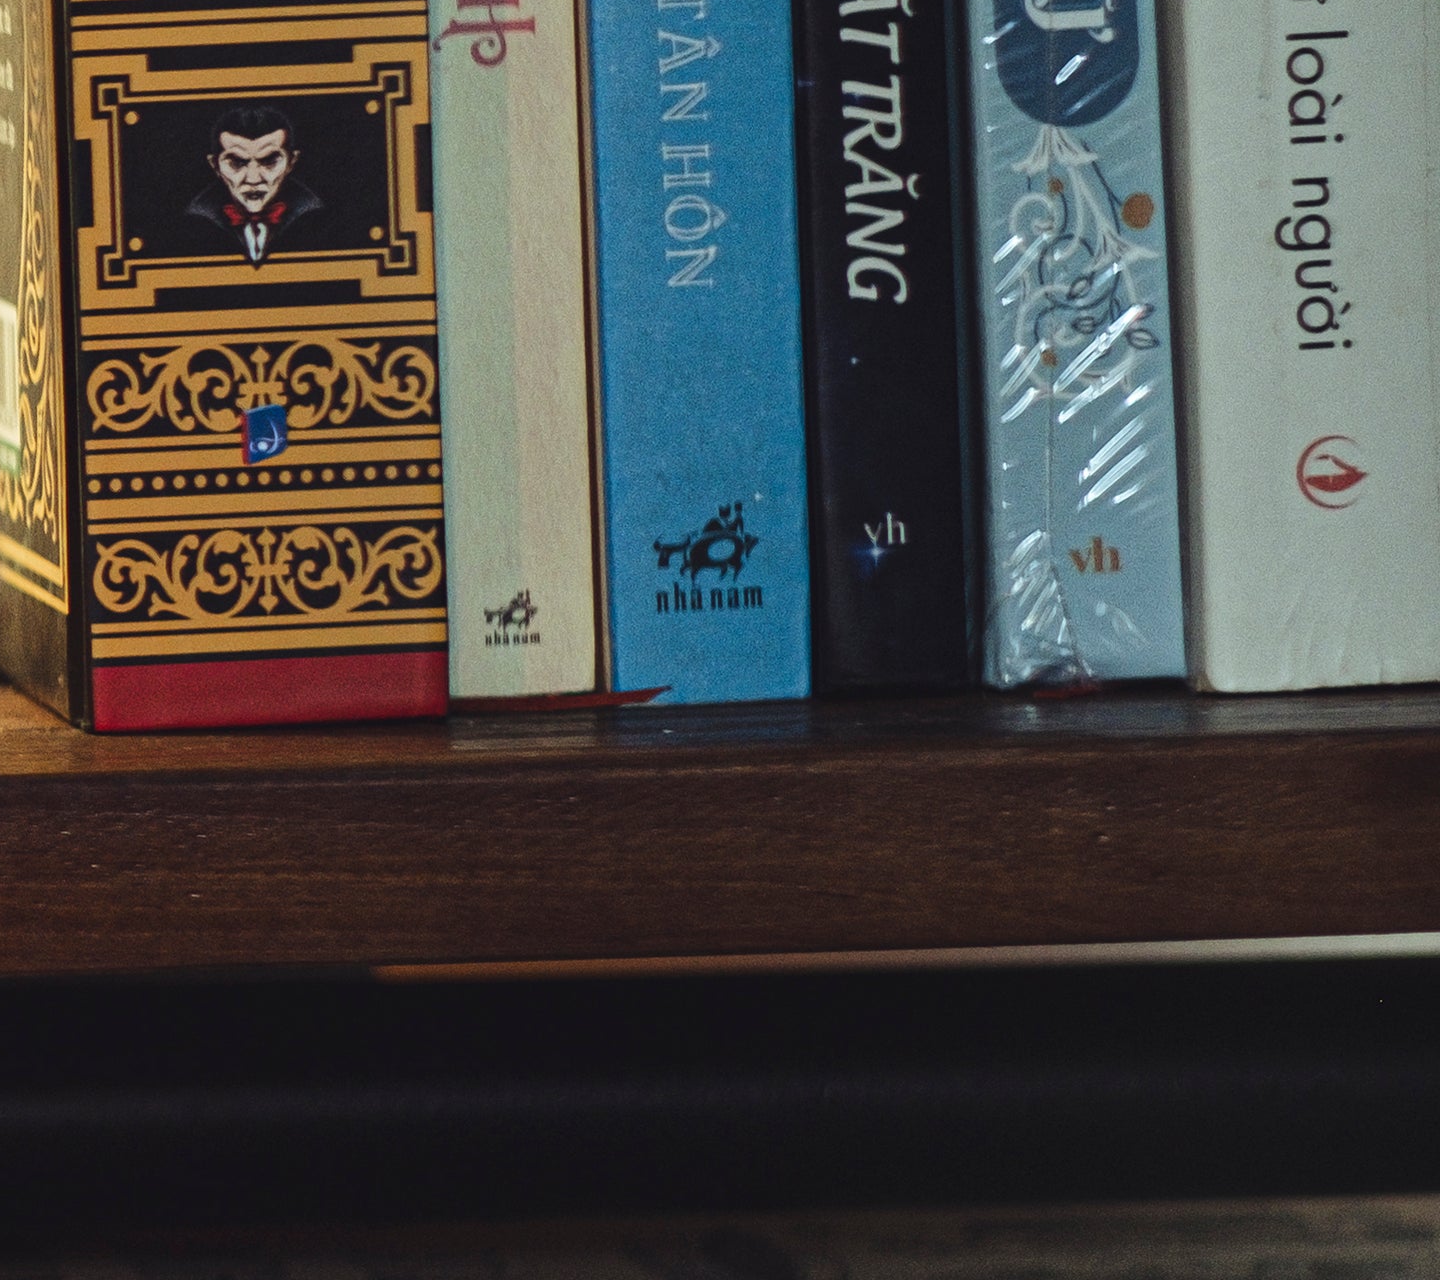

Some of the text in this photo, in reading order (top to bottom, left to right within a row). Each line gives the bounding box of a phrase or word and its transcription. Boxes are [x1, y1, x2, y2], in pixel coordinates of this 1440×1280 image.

[1284, 31, 1348, 147] loài
[661, 143, 726, 289] HÔN
[840, 78, 922, 305] TRĂNG
[1275, 176, 1352, 350] người
[711, 586, 763, 612] nam
